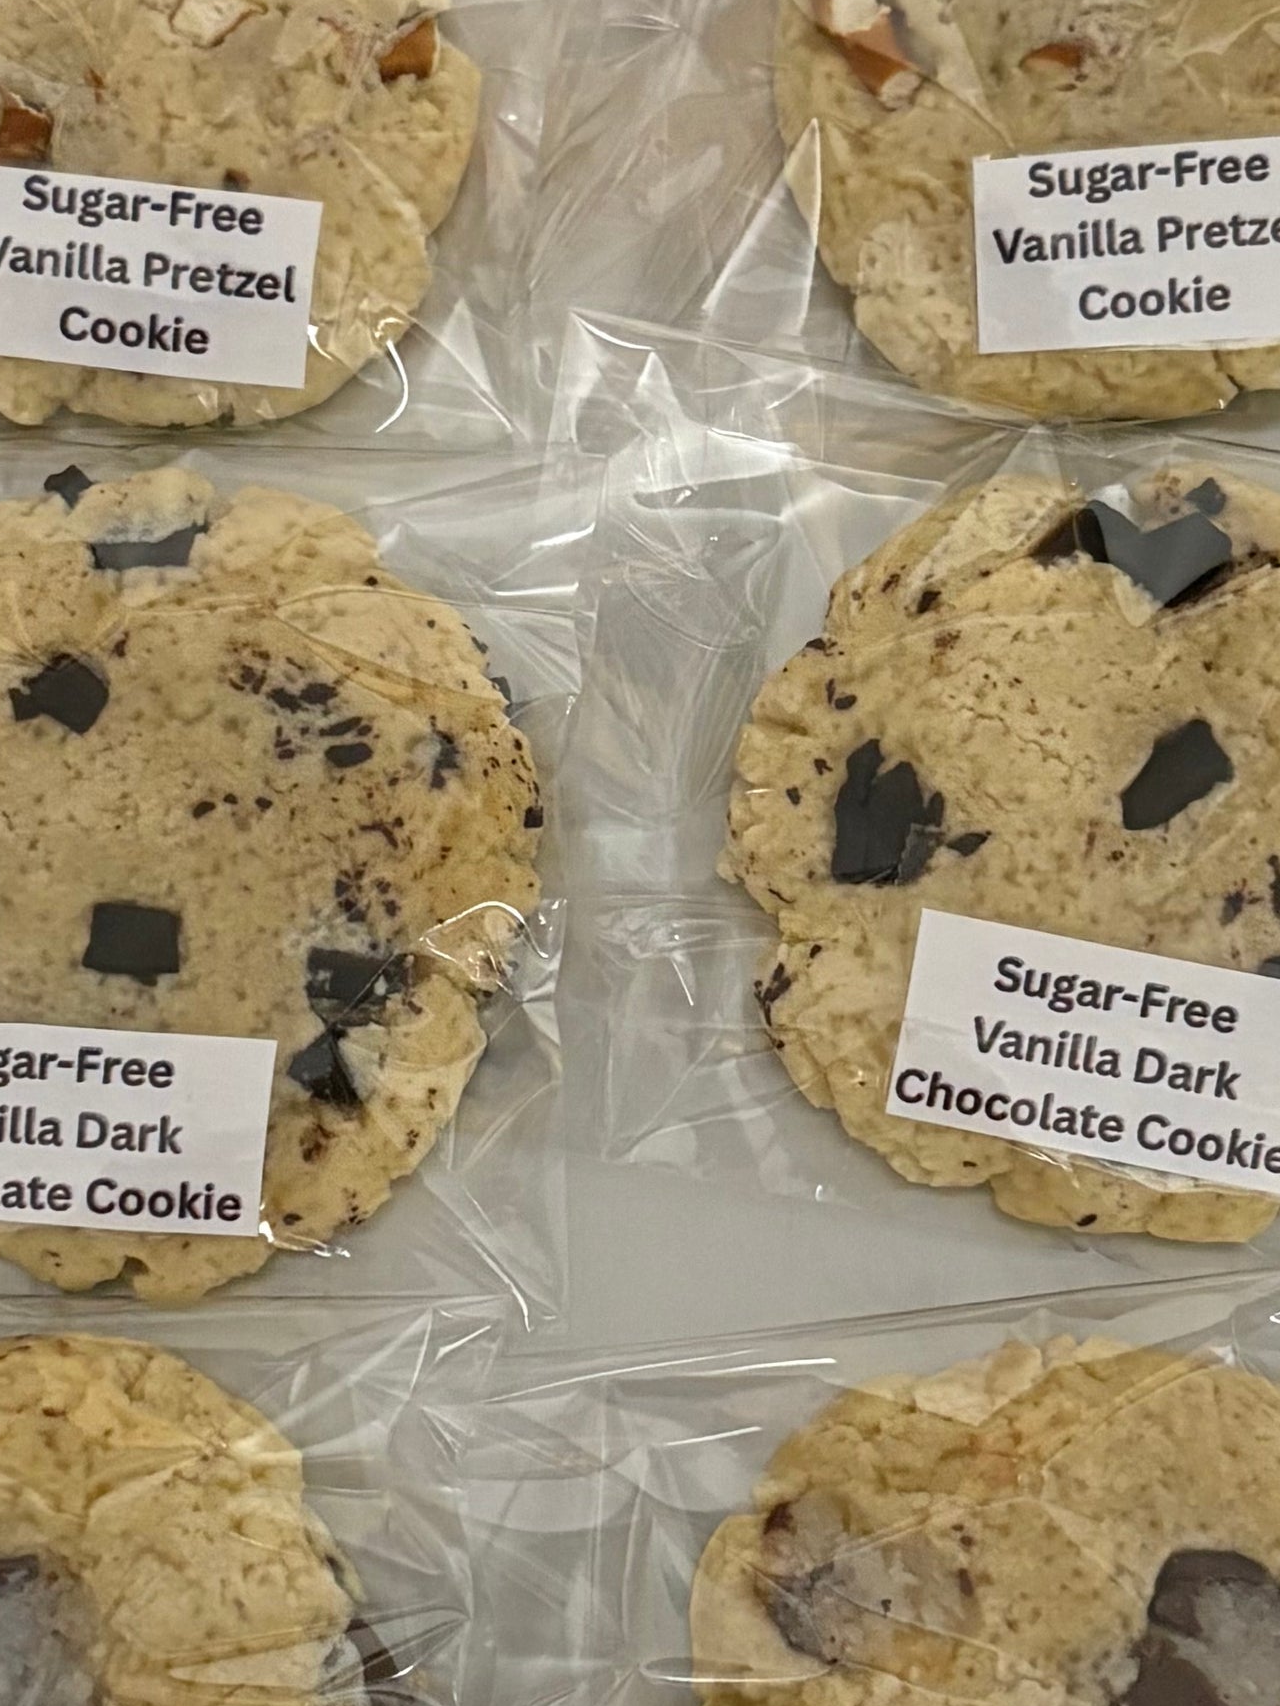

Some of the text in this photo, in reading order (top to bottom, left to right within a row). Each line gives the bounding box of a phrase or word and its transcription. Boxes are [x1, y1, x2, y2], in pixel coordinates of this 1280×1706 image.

[1028, 150, 1270, 204] Sugar-Free
[22, 174, 264, 236] Sugar-Free
[991, 218, 1145, 265] Vanilla
[143, 251, 296, 304] Pretzel
[1078, 275, 1231, 321] Cookie
[59, 305, 210, 355] Cookie
[993, 955, 1239, 1034] Sugar-Free
[973, 1015, 1242, 1101] Vanilla Dark
[894, 1068, 1125, 1143] Chocolate
[75, 1111, 183, 1155] Dark
[85, 1177, 243, 1222] Cookie
